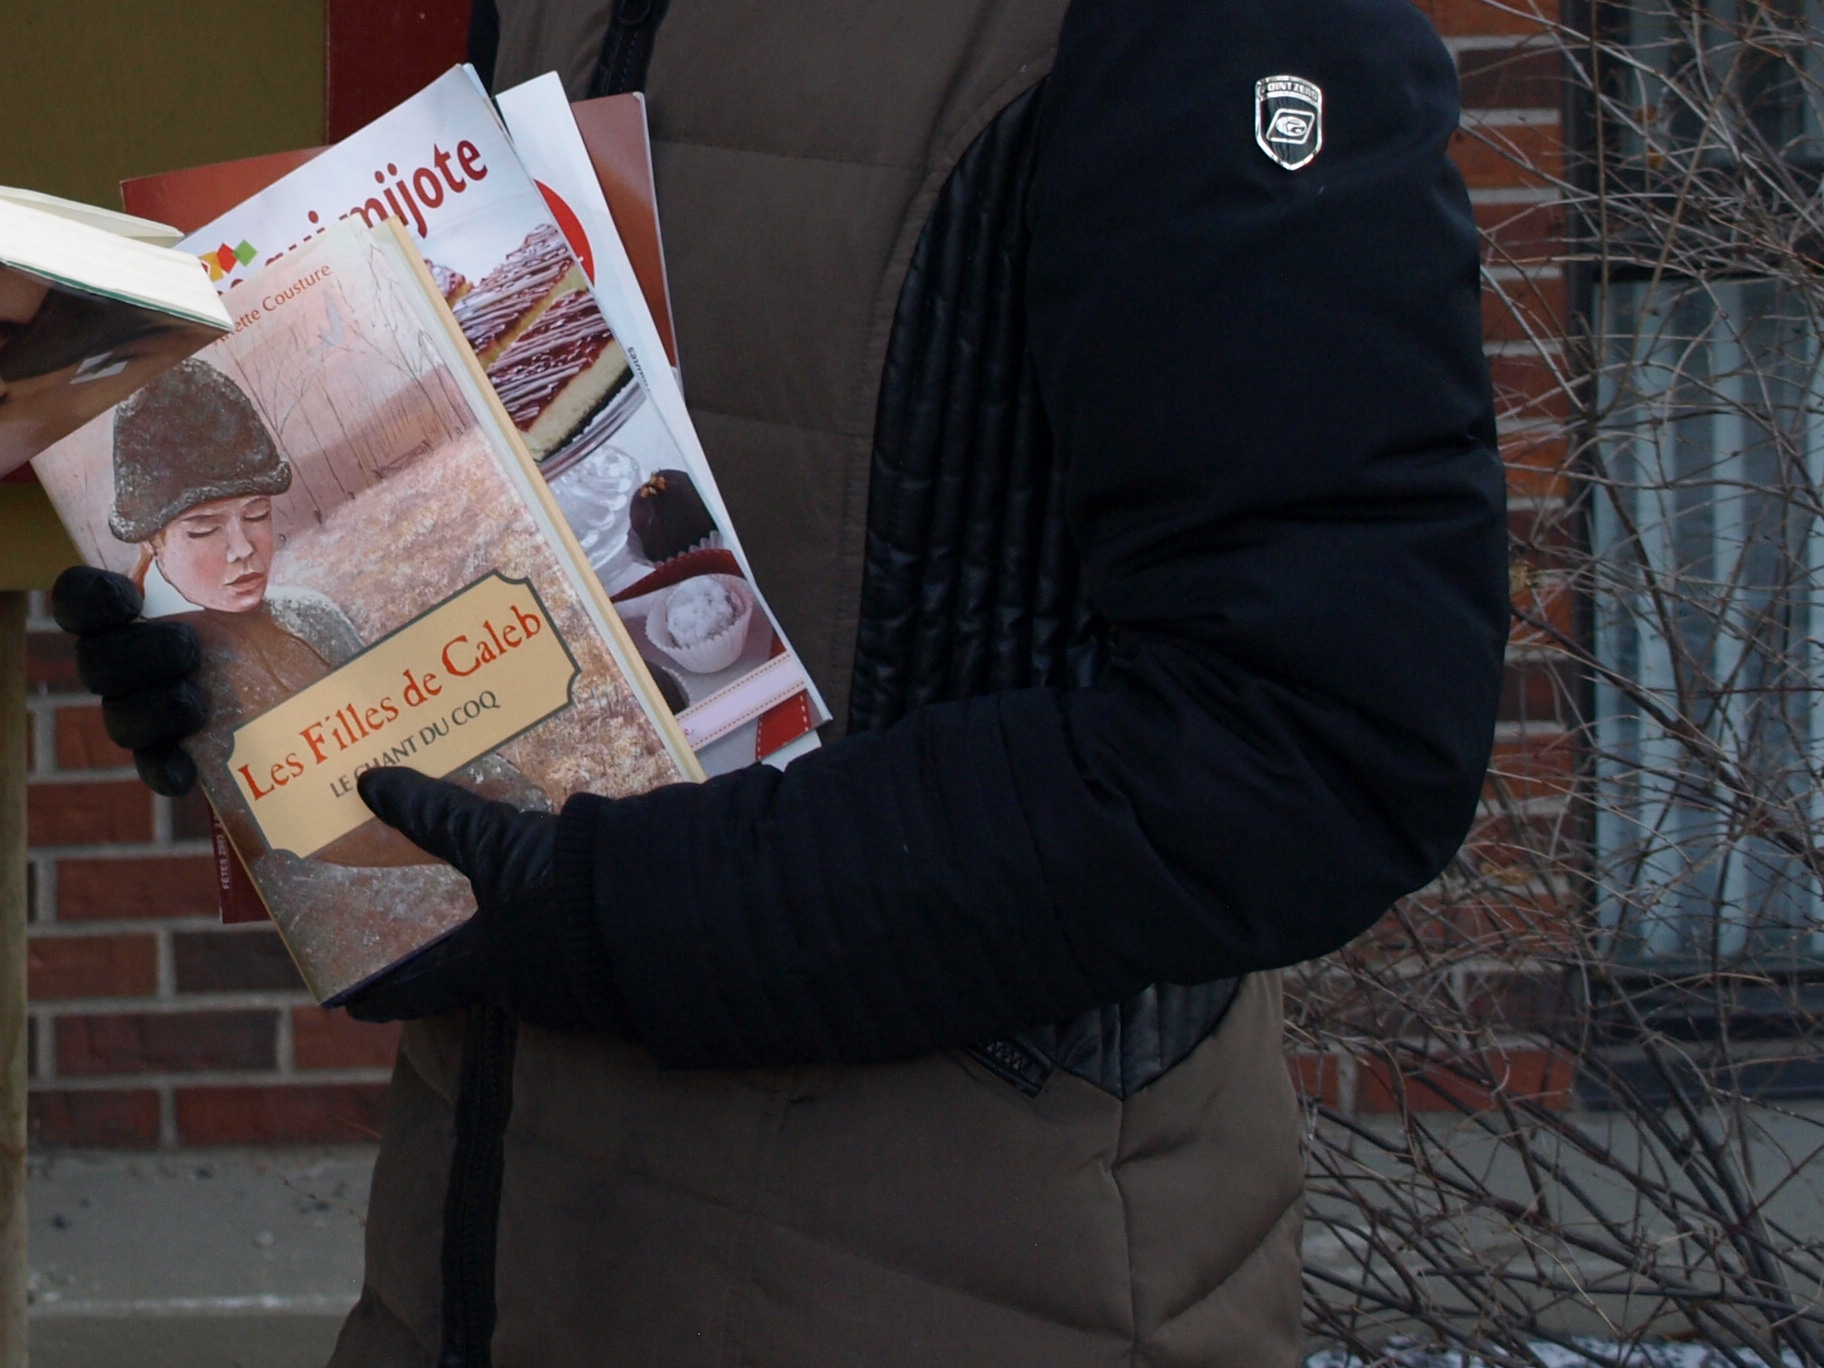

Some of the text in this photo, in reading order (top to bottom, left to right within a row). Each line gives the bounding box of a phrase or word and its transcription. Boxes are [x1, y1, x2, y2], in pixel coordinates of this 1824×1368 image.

[262, 265, 332, 312] Cousture
[238, 604, 542, 801] Les Filles de Caleb
[329, 773, 354, 799] LE
[421, 716, 450, 746] DU
[451, 689, 502, 726] COQ
